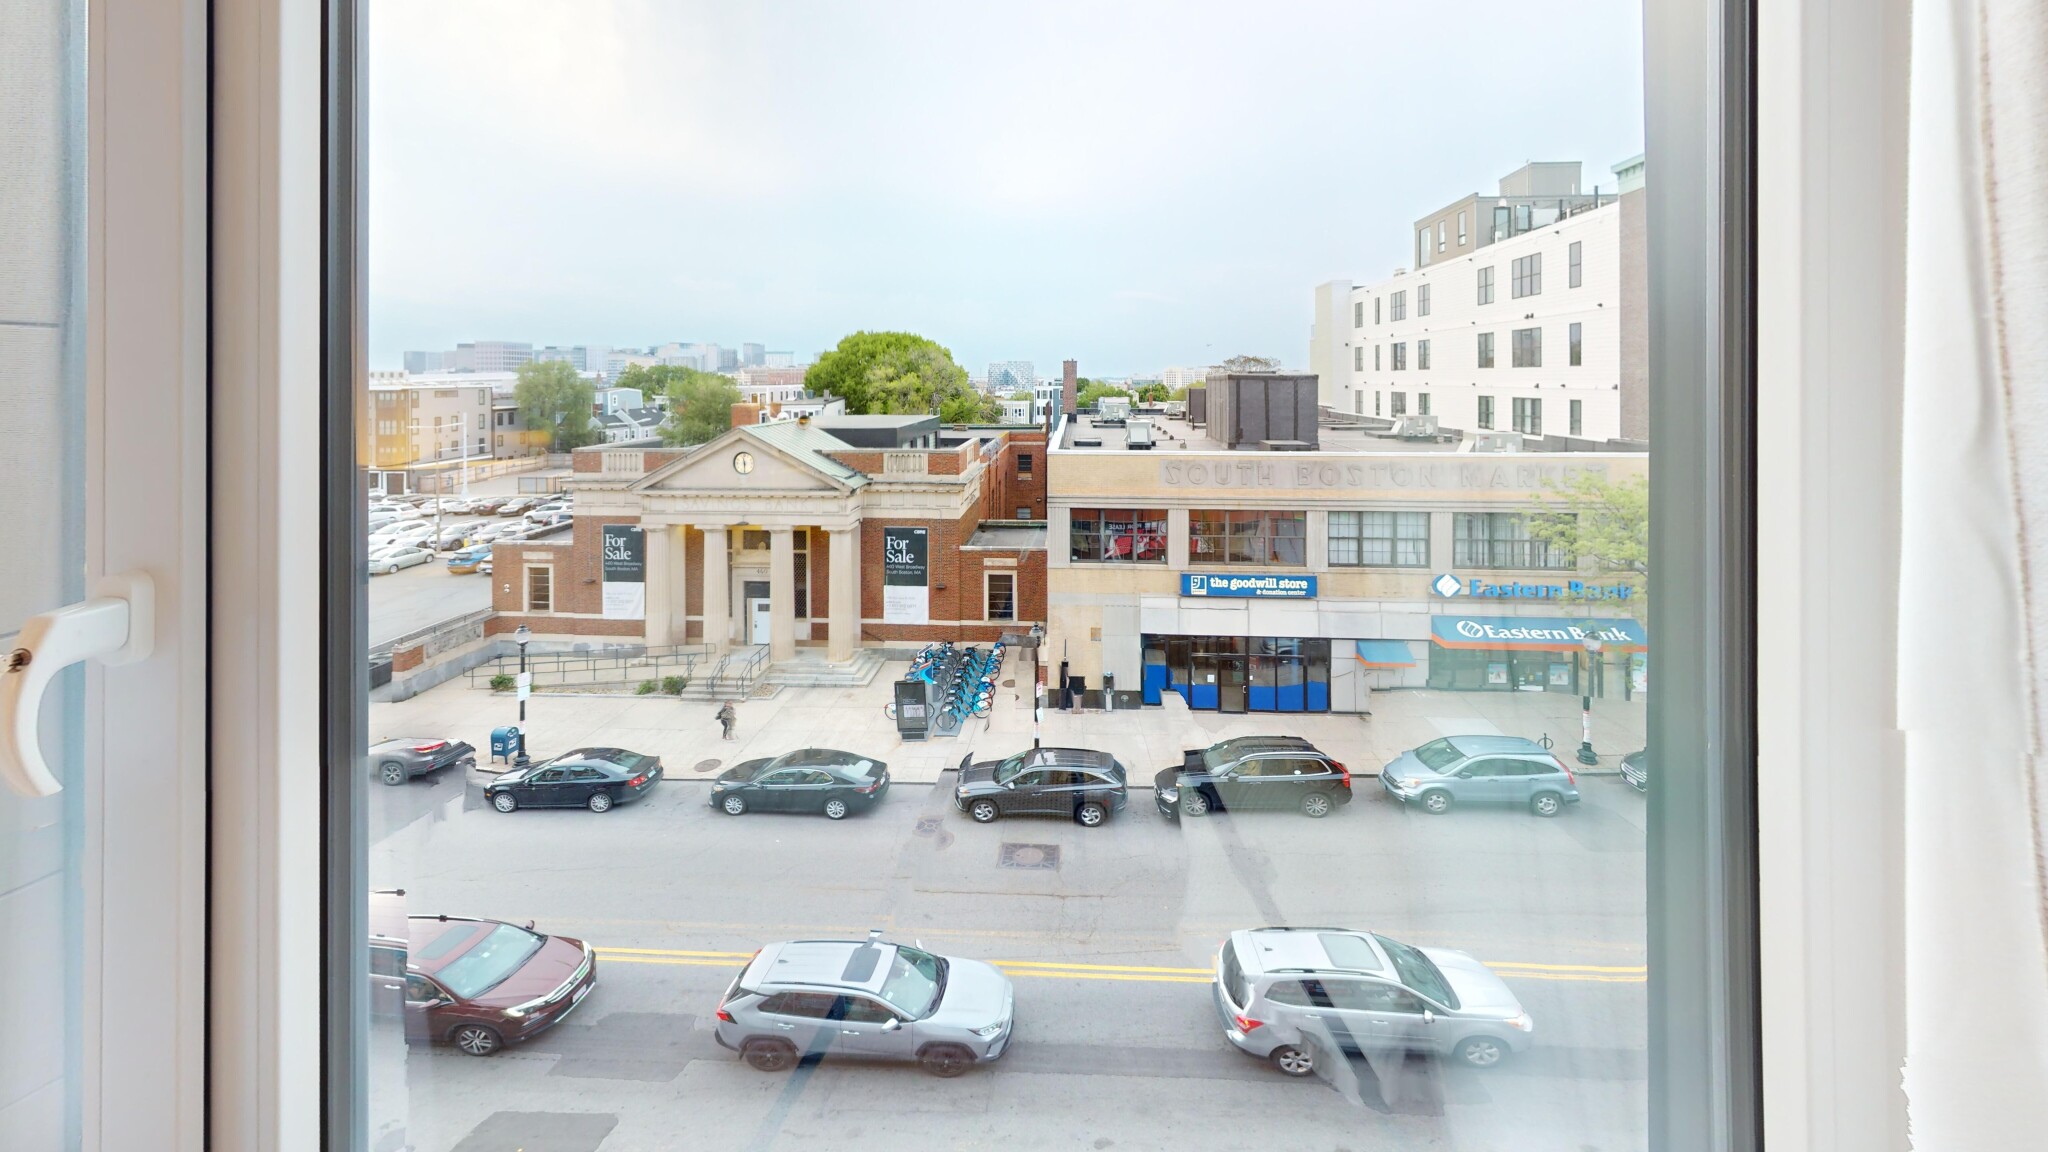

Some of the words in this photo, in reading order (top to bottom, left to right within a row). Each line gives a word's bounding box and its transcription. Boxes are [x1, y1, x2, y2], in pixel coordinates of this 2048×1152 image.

[1164, 463, 1274, 485] SOUTH
[1297, 463, 1437, 487] BOSTON
[683, 498, 751, 510] SAVINGS
[765, 499, 808, 510] BANK
[605, 533, 627, 547] For
[886, 536, 910, 550] For
[605, 546, 632, 560] Sale
[886, 549, 914, 564] Sale
[1210, 577, 1228, 588] the
[1229, 577, 1277, 590] goodwill
[1278, 579, 1308, 589] store
[1468, 579, 1563, 599] Eastern
[1483, 624, 1566, 641] Eastern
[1567, 626, 1633, 641] Bnk
